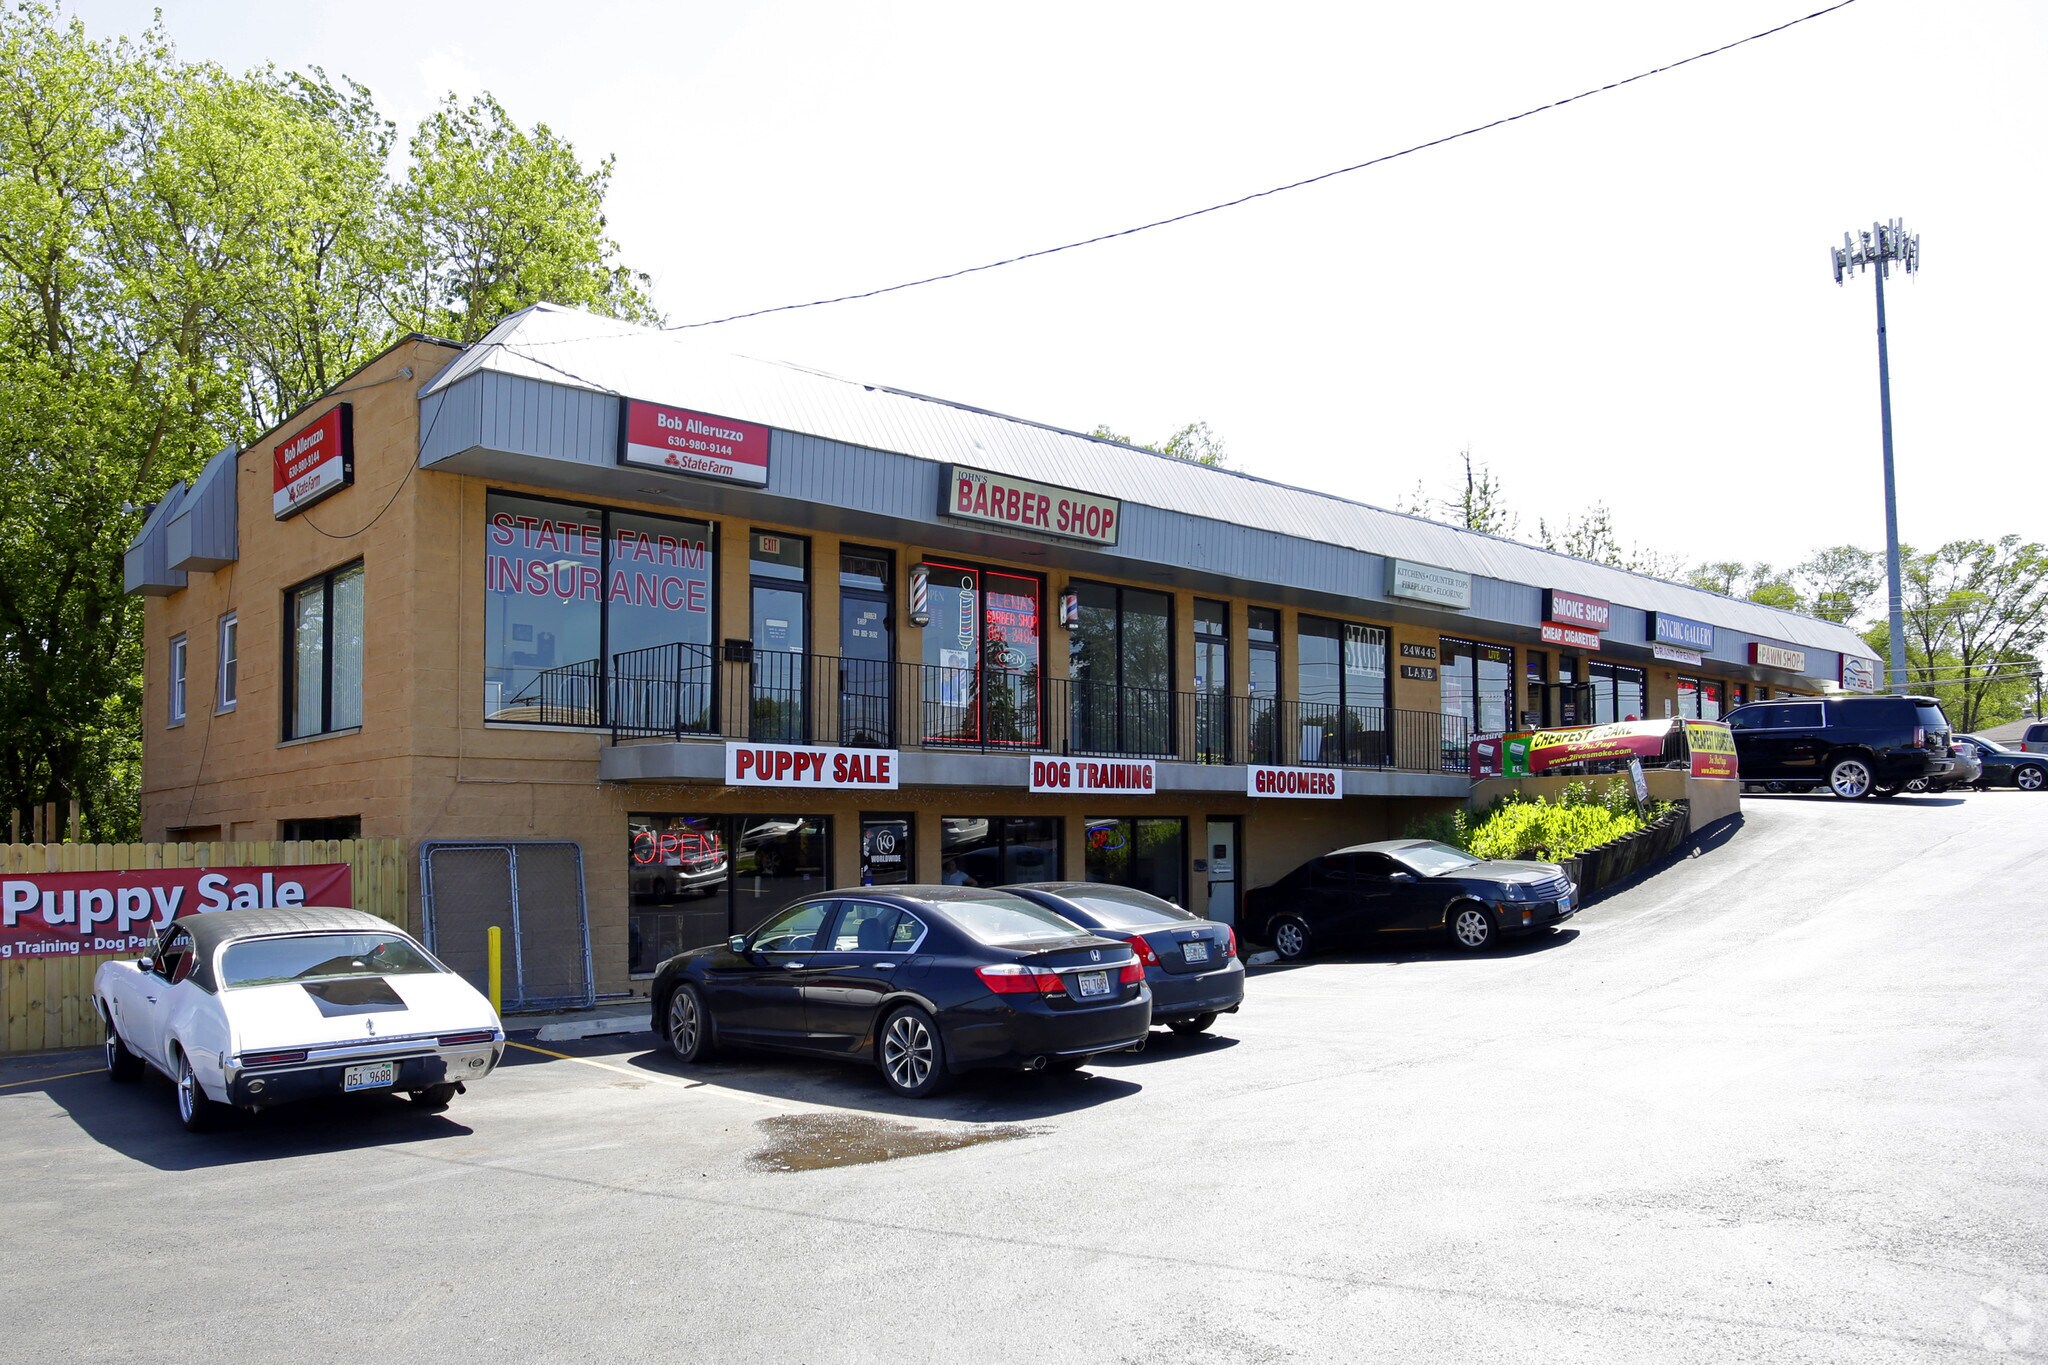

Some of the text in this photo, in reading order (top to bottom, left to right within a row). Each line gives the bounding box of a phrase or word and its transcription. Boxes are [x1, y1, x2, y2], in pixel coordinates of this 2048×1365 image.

[657, 413, 744, 442] Bob Alleruzzo
[284, 428, 324, 465] Bob Alleruzzo
[667, 435, 733, 455] 630-980-9144
[288, 450, 320, 479] 630-980-9144
[956, 471, 988, 484] JOHN'S
[957, 478, 1114, 539] BARBER SHOP
[492, 512, 705, 571] STATE FARM
[763, 537, 778, 552] EXIT
[487, 554, 707, 614] INSURANCE
[1397, 567, 1469, 590] KITCHENS COUNTER TOPS
[1401, 580, 1464, 600] FIREPLACES FLOORING
[988, 592, 1036, 612] ELENA'S
[1552, 596, 1609, 624] SMOKE SHOP
[986, 609, 1037, 628] BARBER SHOP
[1541, 625, 1599, 648] CHEAP CIGARETTES
[1657, 617, 1712, 646] PSYCHIC GALLERY
[998, 652, 1023, 664] OPEN
[1345, 624, 1385, 672] STORE
[1403, 644, 1436, 659] 24W445
[1654, 645, 1701, 664] GRAND OPENING
[1762, 650, 1801, 669] PAWN SHOP
[1407, 667, 1433, 679] LAKE
[1844, 675, 1873, 690] AUTO DEALS
[1534, 728, 1593, 748] CHEAPEST
[1564, 741, 1618, 753] In DuPage
[735, 749, 891, 784] PUPPY SALE
[1548, 748, 1632, 765] www.2livesmoke.com
[1033, 761, 1153, 790] DOG TRAINING
[1255, 769, 1336, 796] GROOMERS
[633, 832, 720, 864] OPEN
[870, 854, 902, 863] WORLDWIDE
[2, 872, 305, 933] Puppy Sale
[15, 940, 80, 955] Training
[94, 937, 125, 952] Dog
[369, 1069, 391, 1083] 9688
